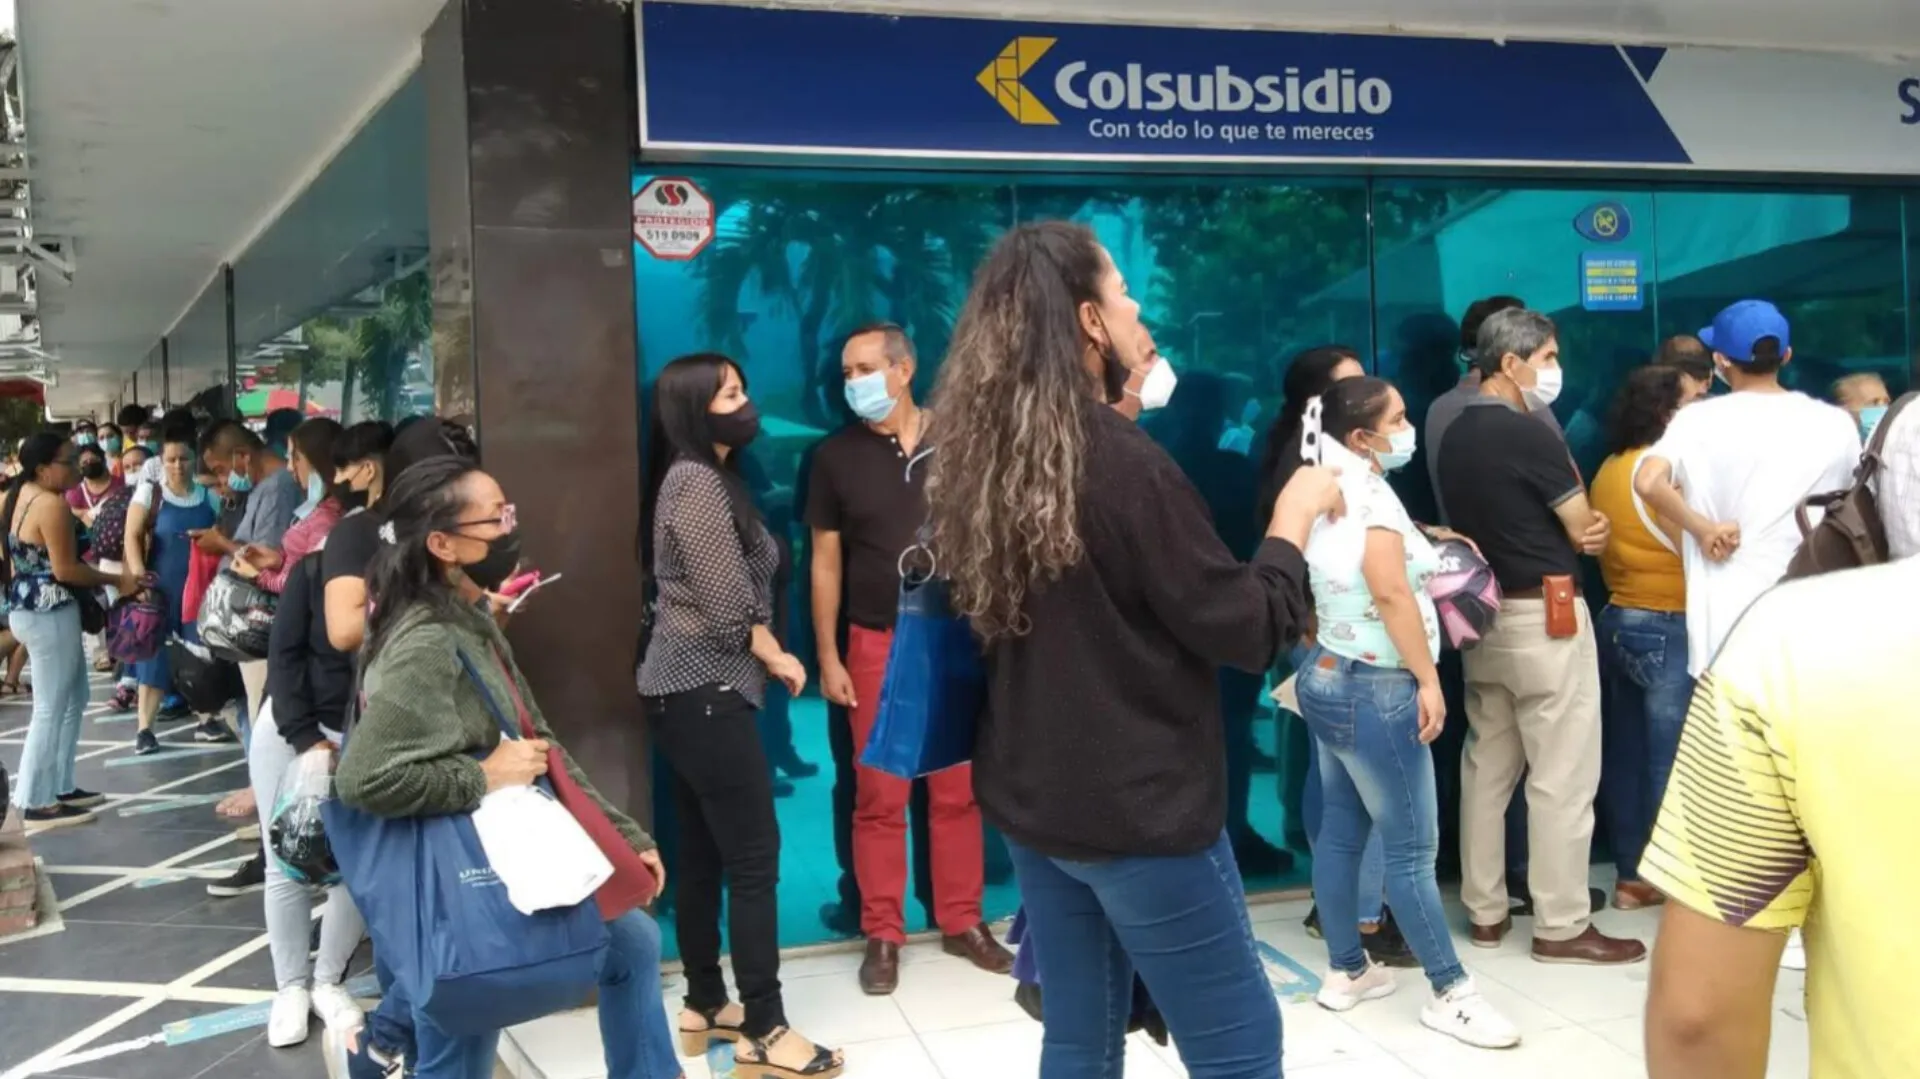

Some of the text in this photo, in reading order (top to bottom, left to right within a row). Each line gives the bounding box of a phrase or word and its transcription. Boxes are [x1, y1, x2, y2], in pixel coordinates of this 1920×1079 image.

[1055, 61, 1392, 114] Colsubsidio
[1089, 118, 1374, 143] Con todo lo que te mereces
[646, 229, 668, 240] 519
